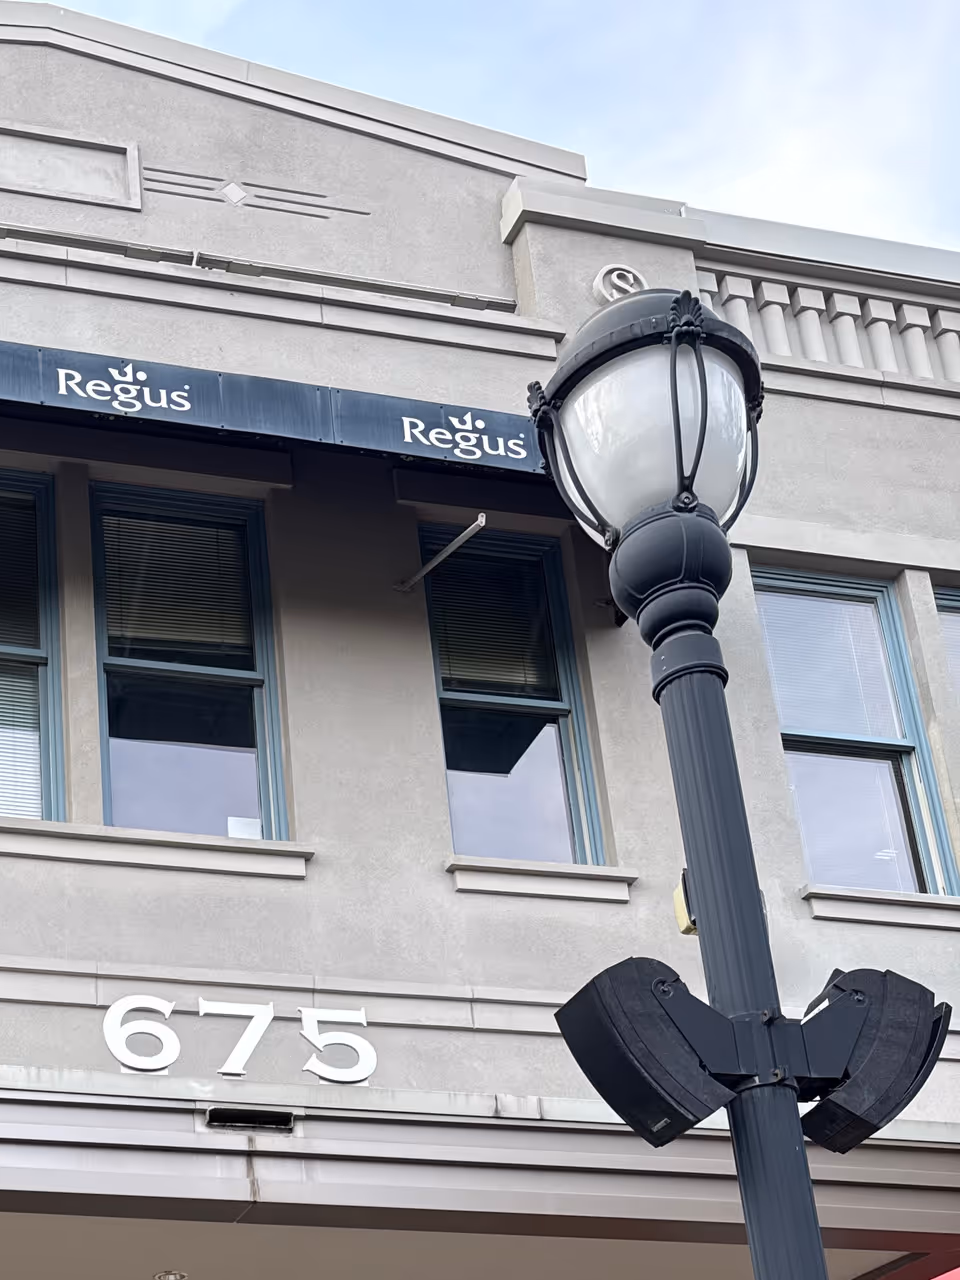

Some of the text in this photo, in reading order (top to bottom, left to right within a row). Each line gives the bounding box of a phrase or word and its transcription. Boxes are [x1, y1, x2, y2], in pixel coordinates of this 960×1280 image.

[57, 366, 192, 412] Regus
[401, 415, 528, 460] Regus
[102, 994, 378, 1084] 675
